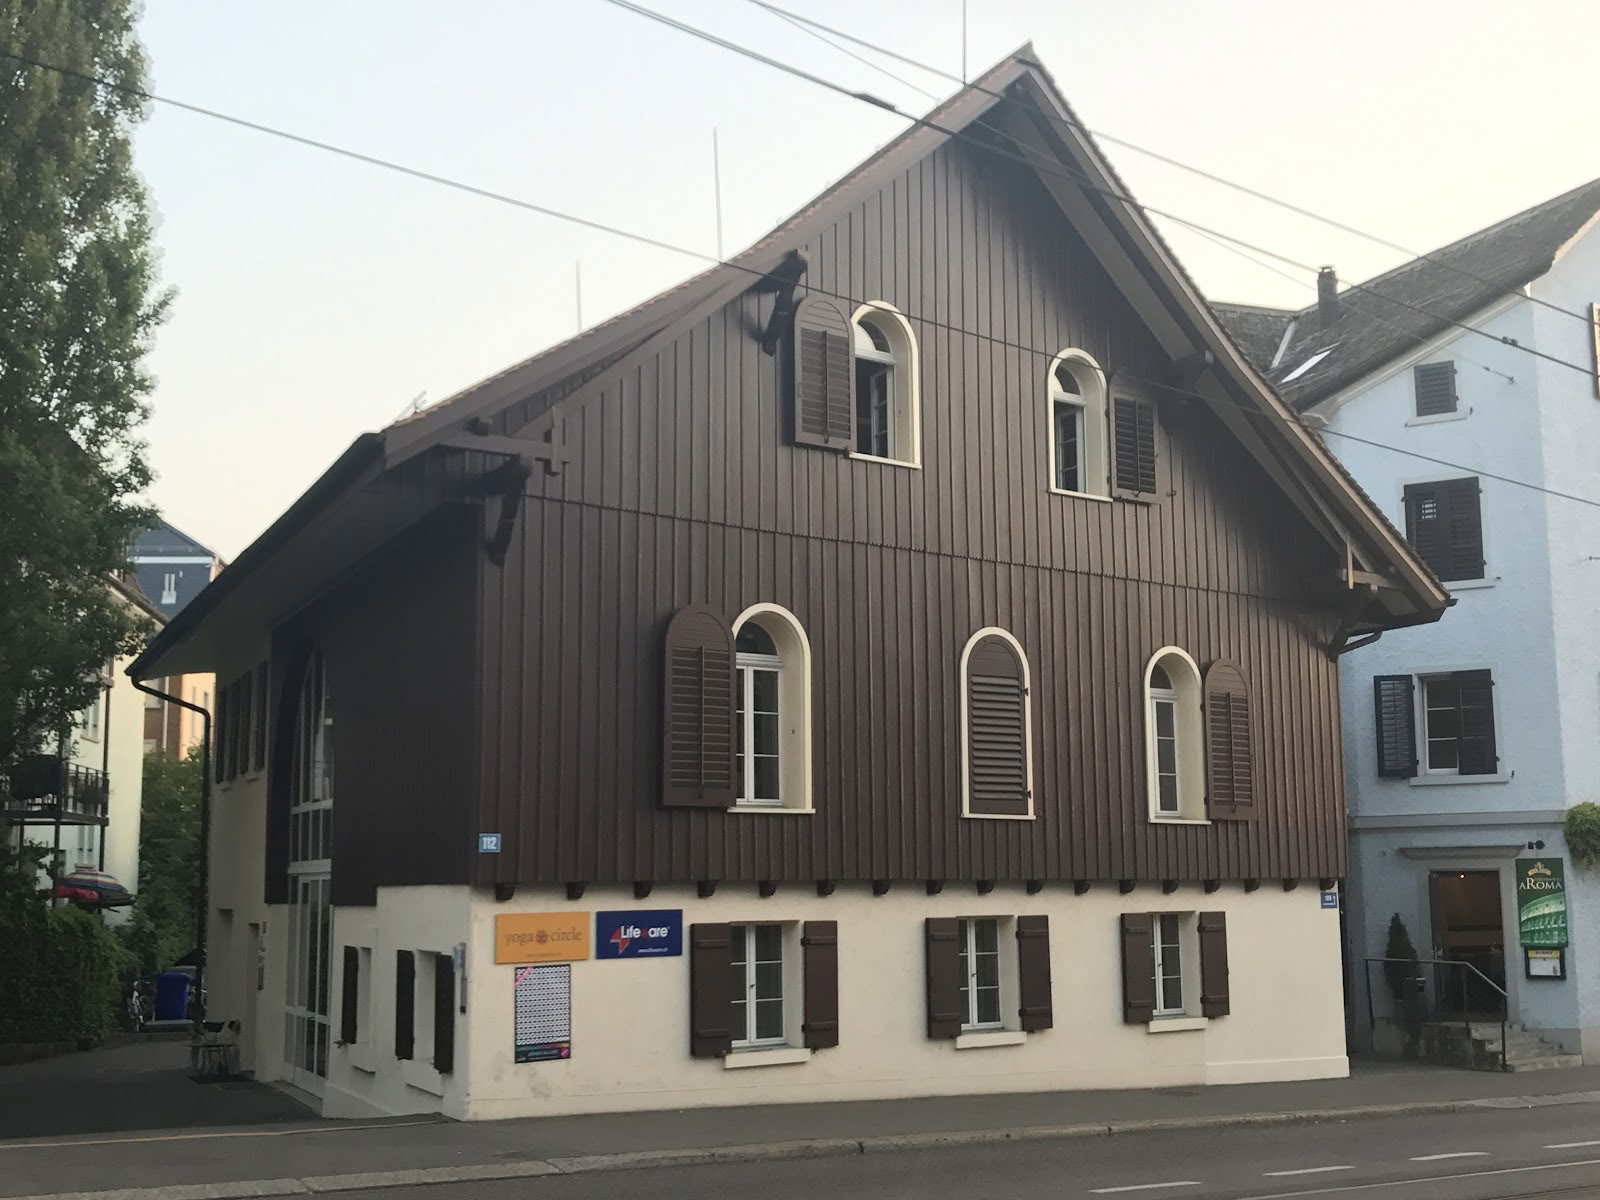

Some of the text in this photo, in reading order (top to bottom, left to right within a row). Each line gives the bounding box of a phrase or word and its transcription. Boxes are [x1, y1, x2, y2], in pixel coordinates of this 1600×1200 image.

[482, 836, 497, 850] 112
[504, 926, 583, 947] yoga circle
